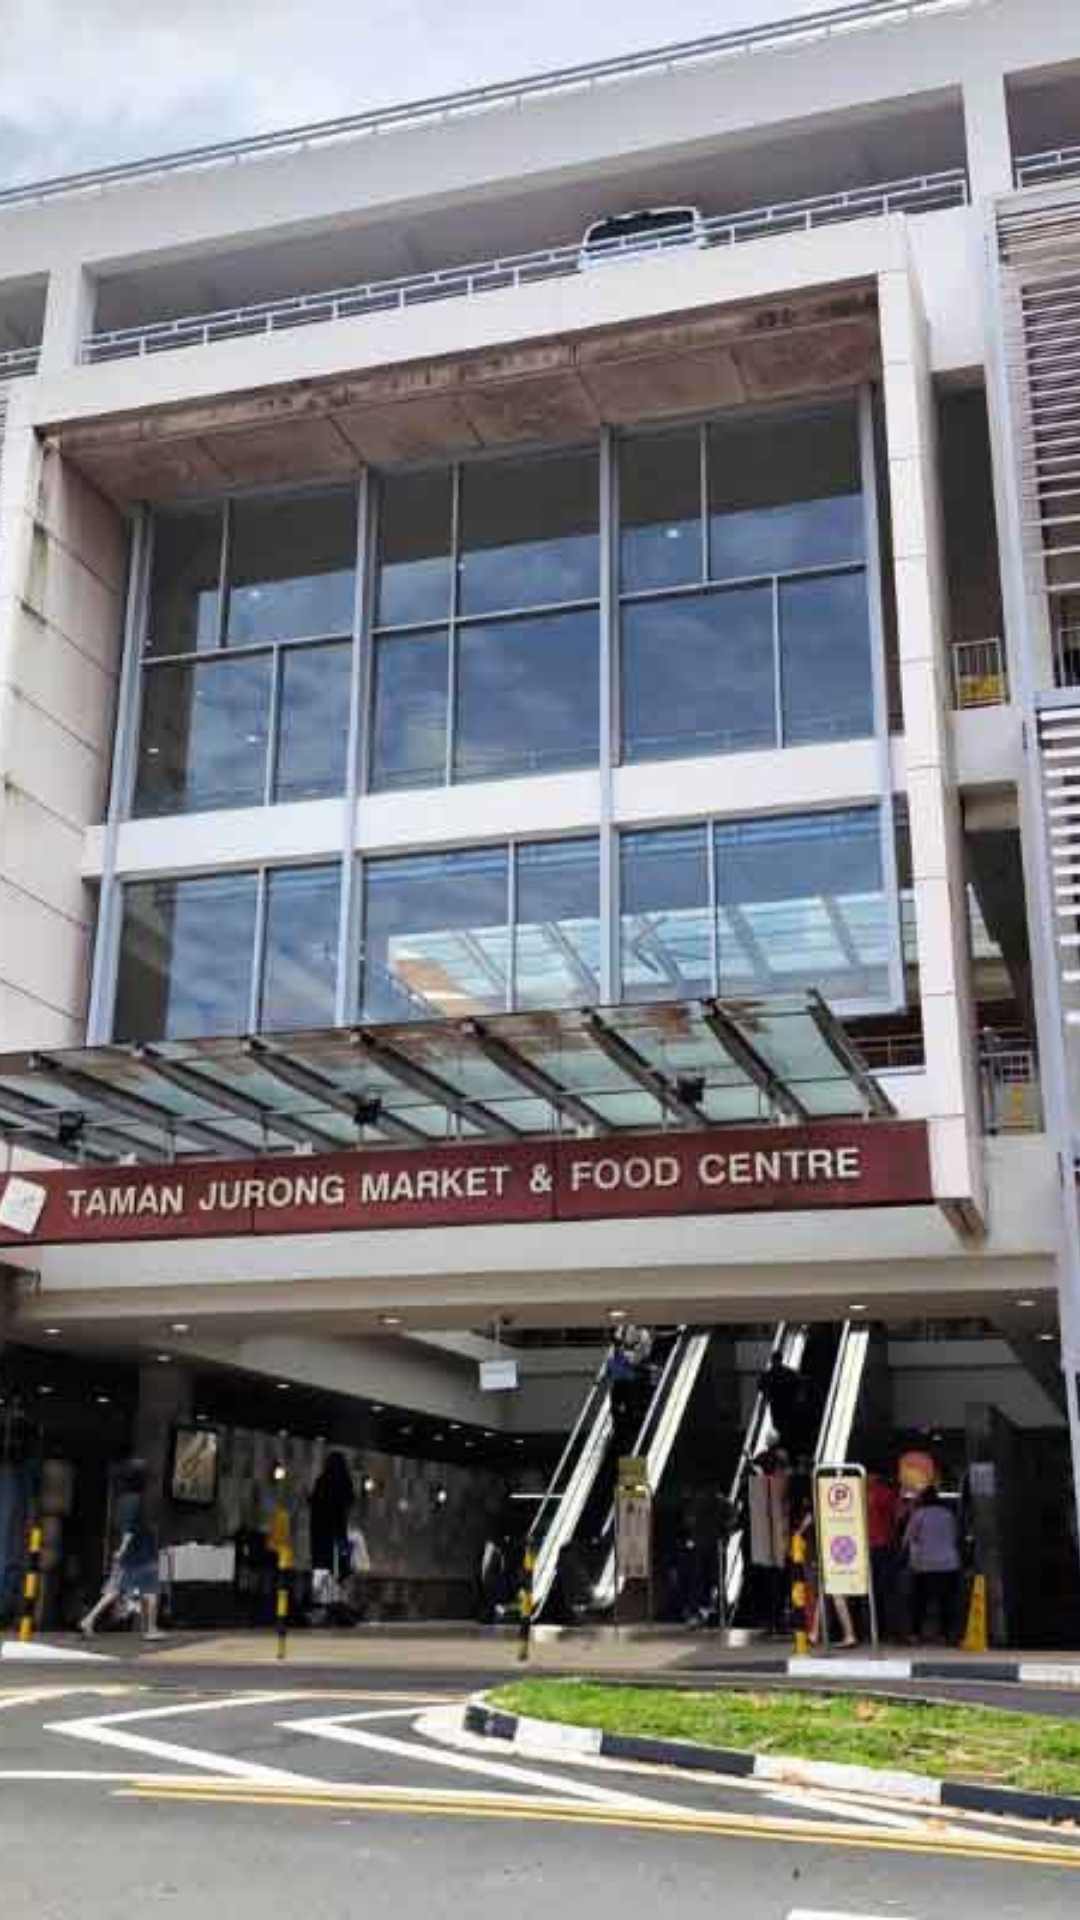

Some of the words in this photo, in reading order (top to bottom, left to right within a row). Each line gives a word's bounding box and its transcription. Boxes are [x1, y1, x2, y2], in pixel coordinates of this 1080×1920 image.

[68, 1185, 184, 1217] TAMAN
[199, 1175, 346, 1212] JURONG
[361, 1165, 512, 1202] MARKET
[529, 1163, 553, 1194] &
[571, 1156, 680, 1192] FOOD
[698, 1147, 862, 1185] CENTRE
